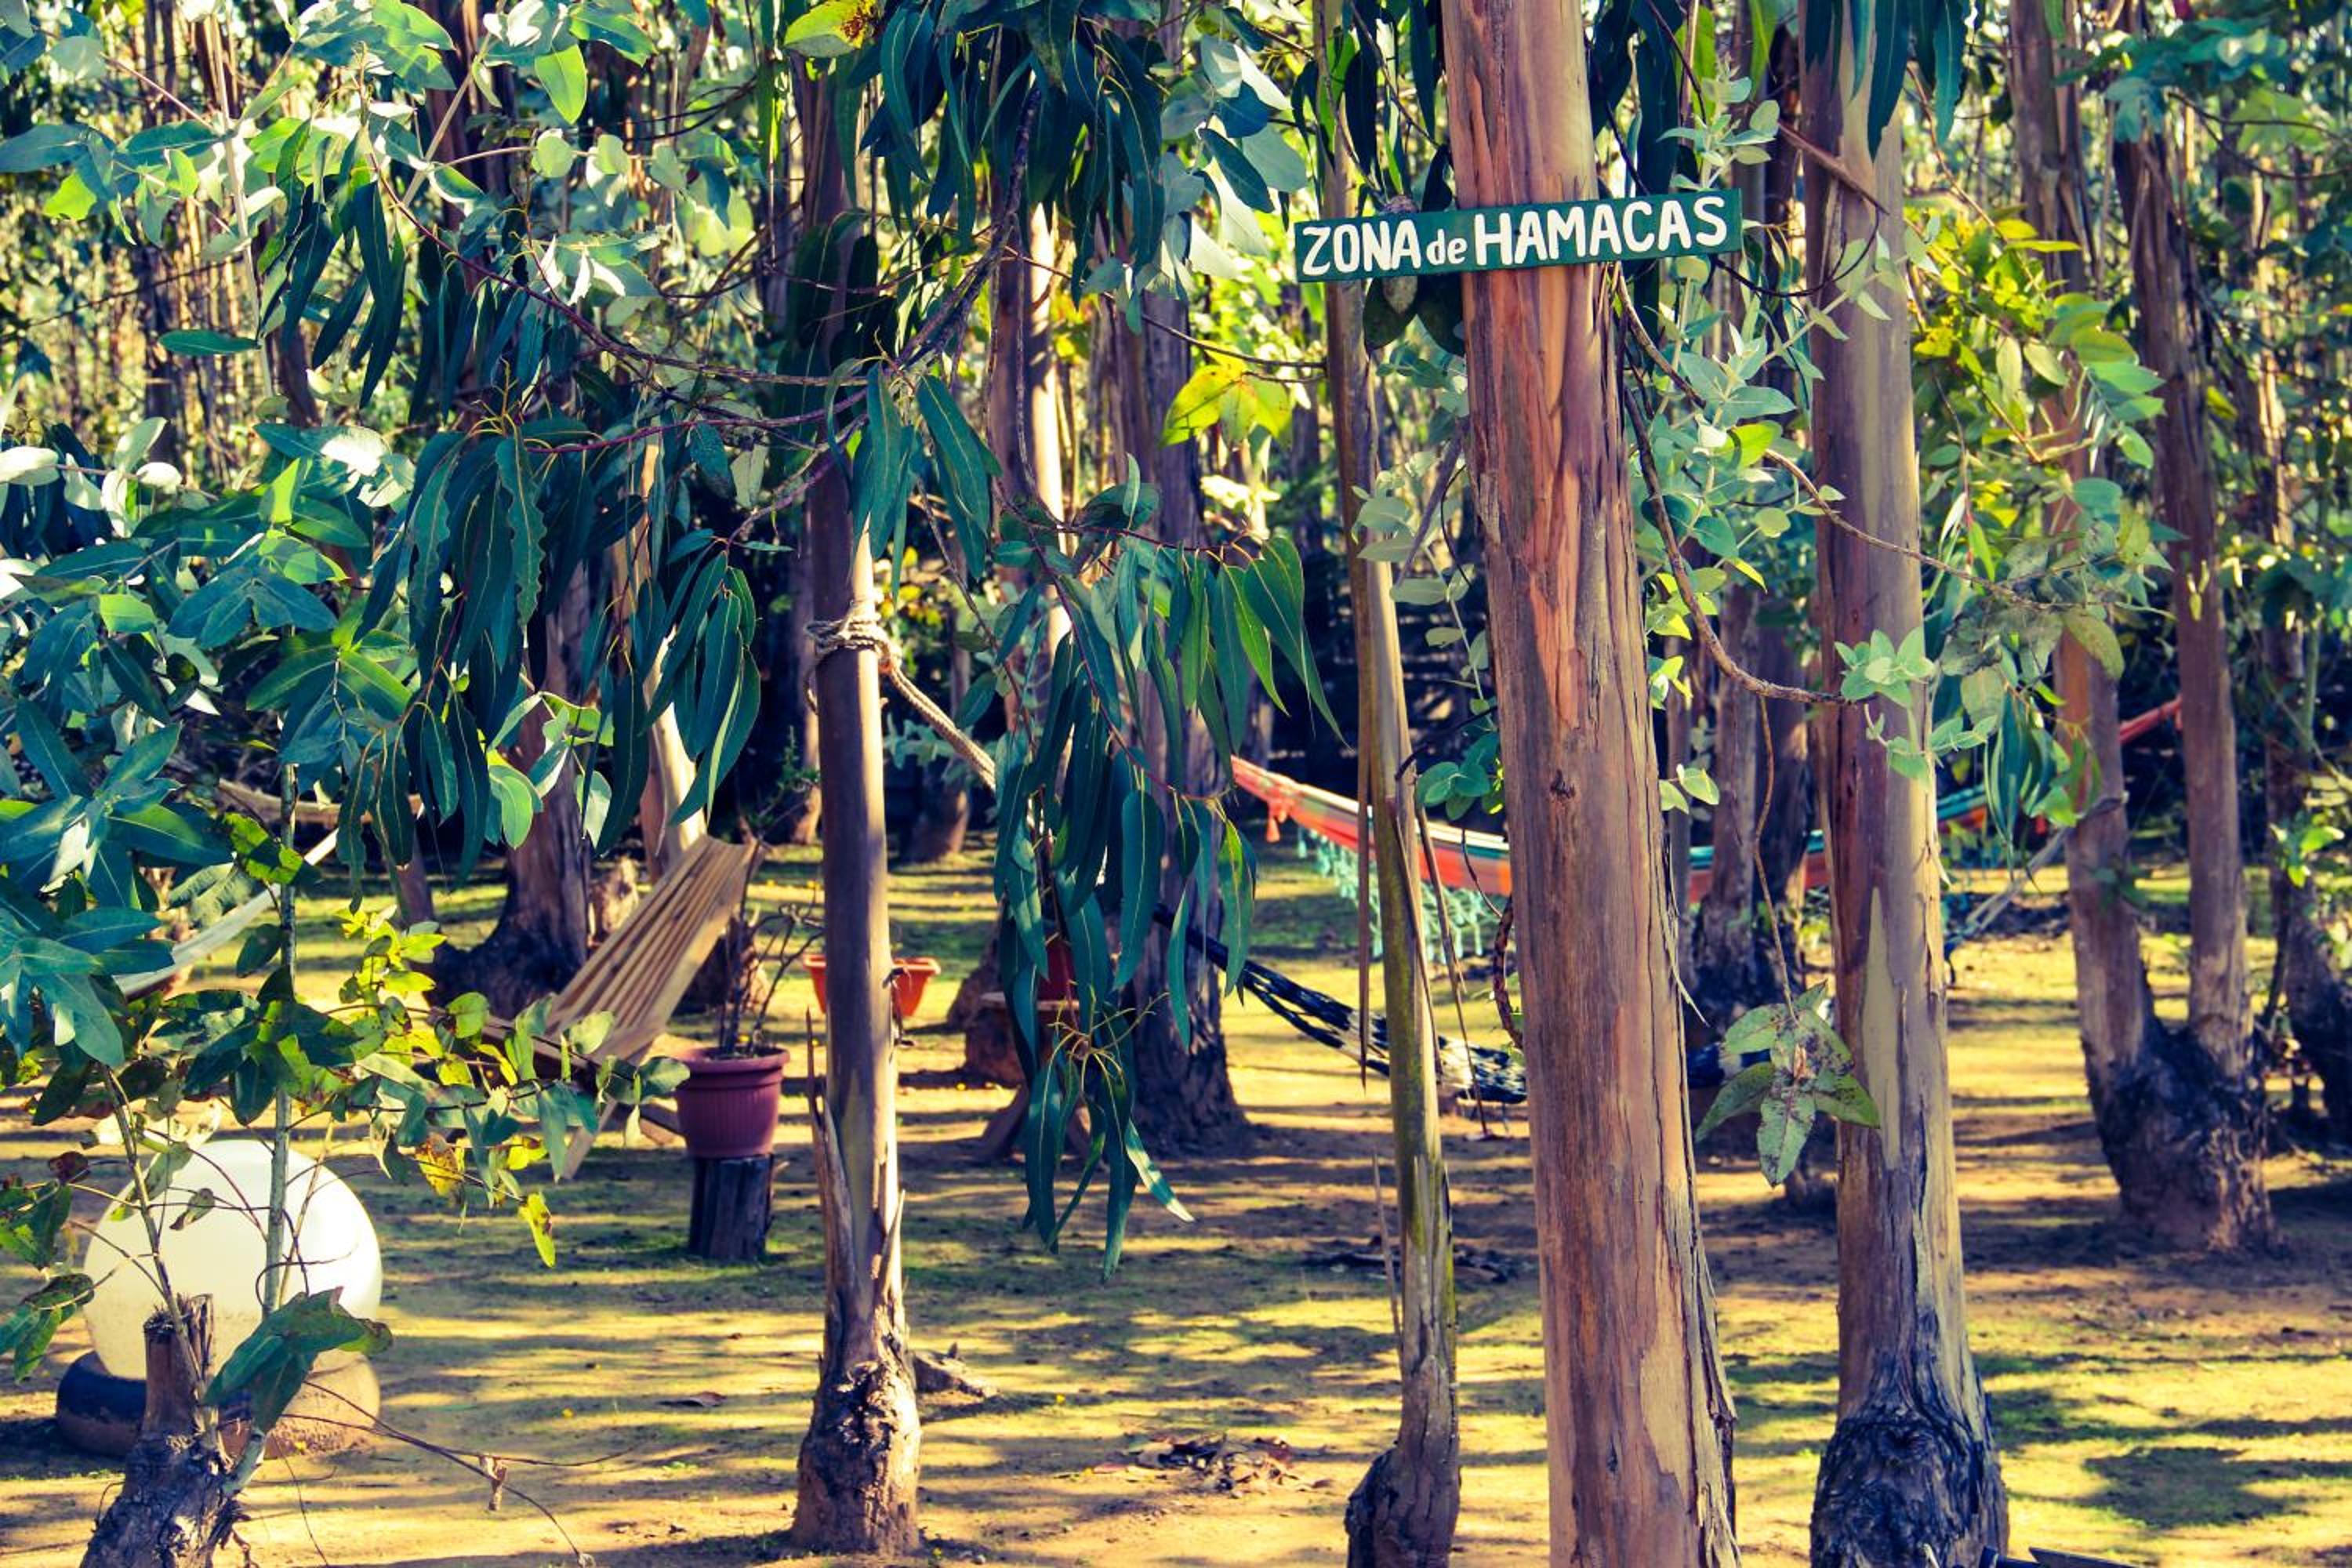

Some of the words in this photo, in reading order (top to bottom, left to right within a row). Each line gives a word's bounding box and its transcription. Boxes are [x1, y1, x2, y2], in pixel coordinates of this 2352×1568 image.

[1302, 219, 1421, 276] ZONA
[1426, 228, 1468, 266] de
[1474, 196, 1728, 266] HAMACAS
